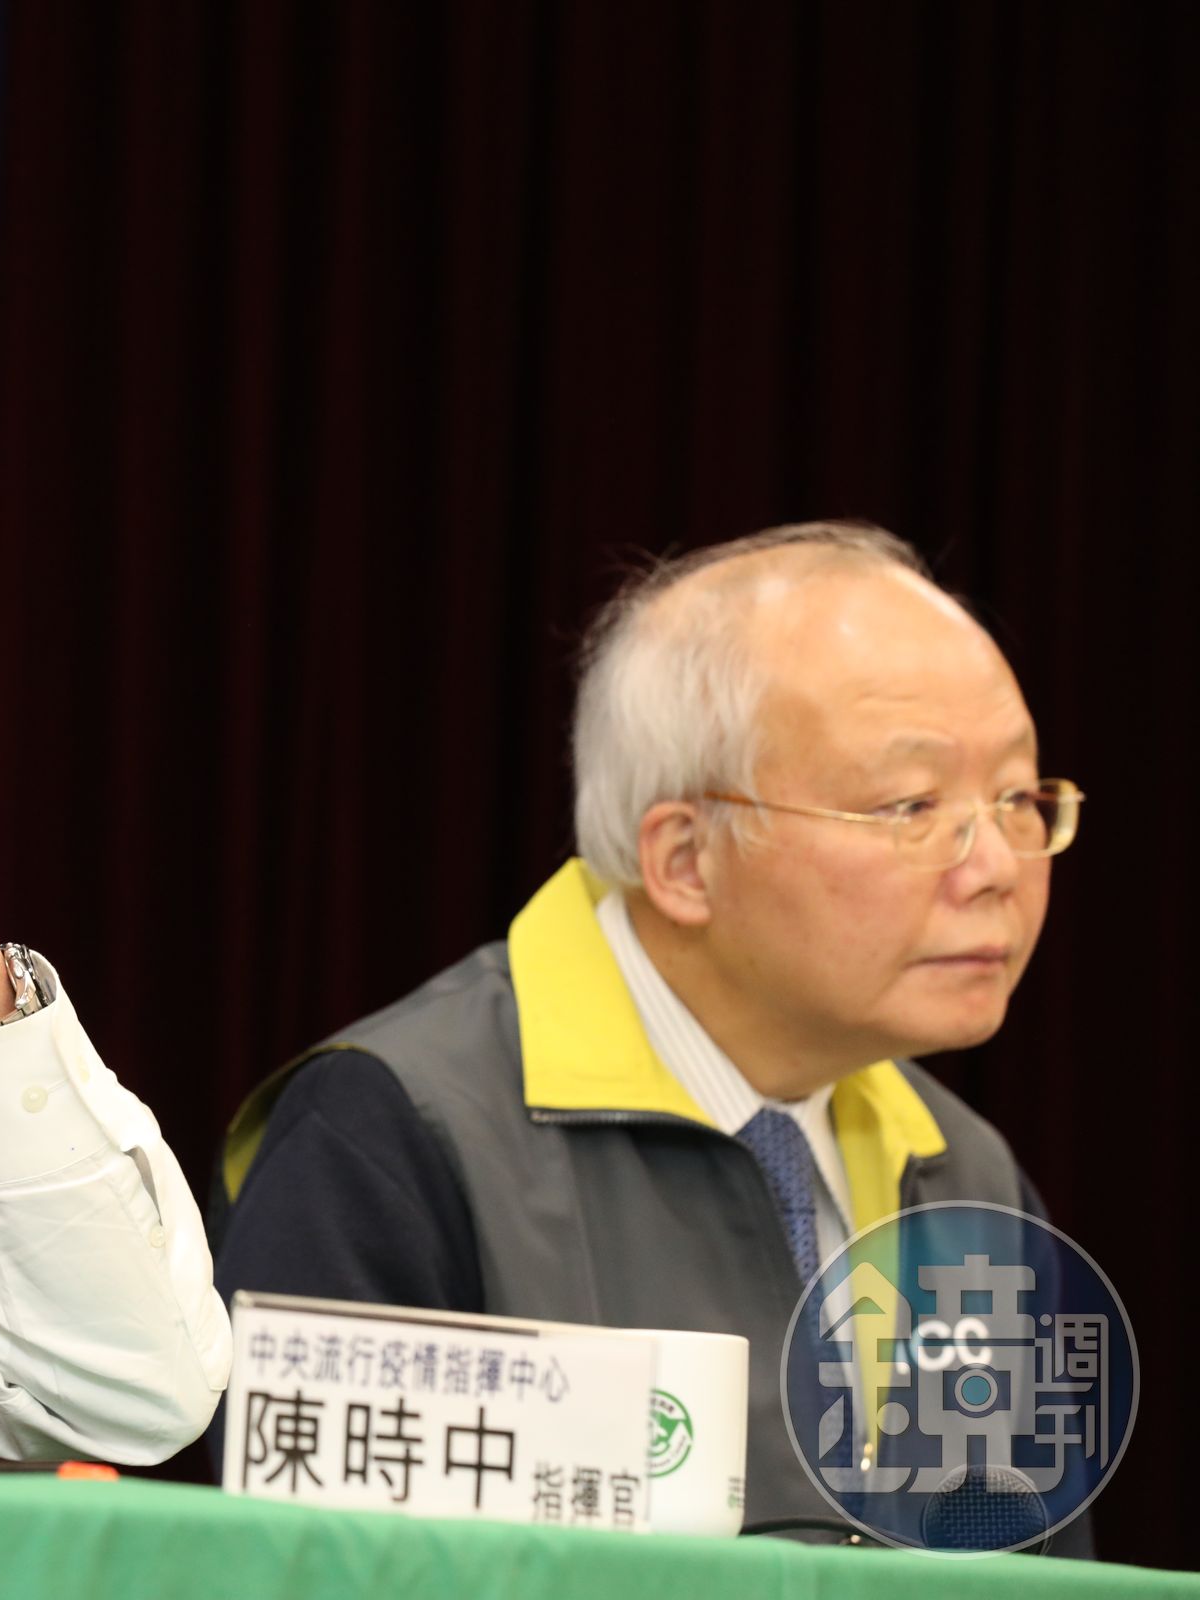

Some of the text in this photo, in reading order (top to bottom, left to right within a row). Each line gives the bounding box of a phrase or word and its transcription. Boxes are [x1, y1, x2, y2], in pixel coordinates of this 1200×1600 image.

[248, 1326, 572, 1404] 中央流行疫情指揮中心
[896, 1317, 993, 1376] CC
[242, 1389, 641, 1528] 陳時中 指揮官
